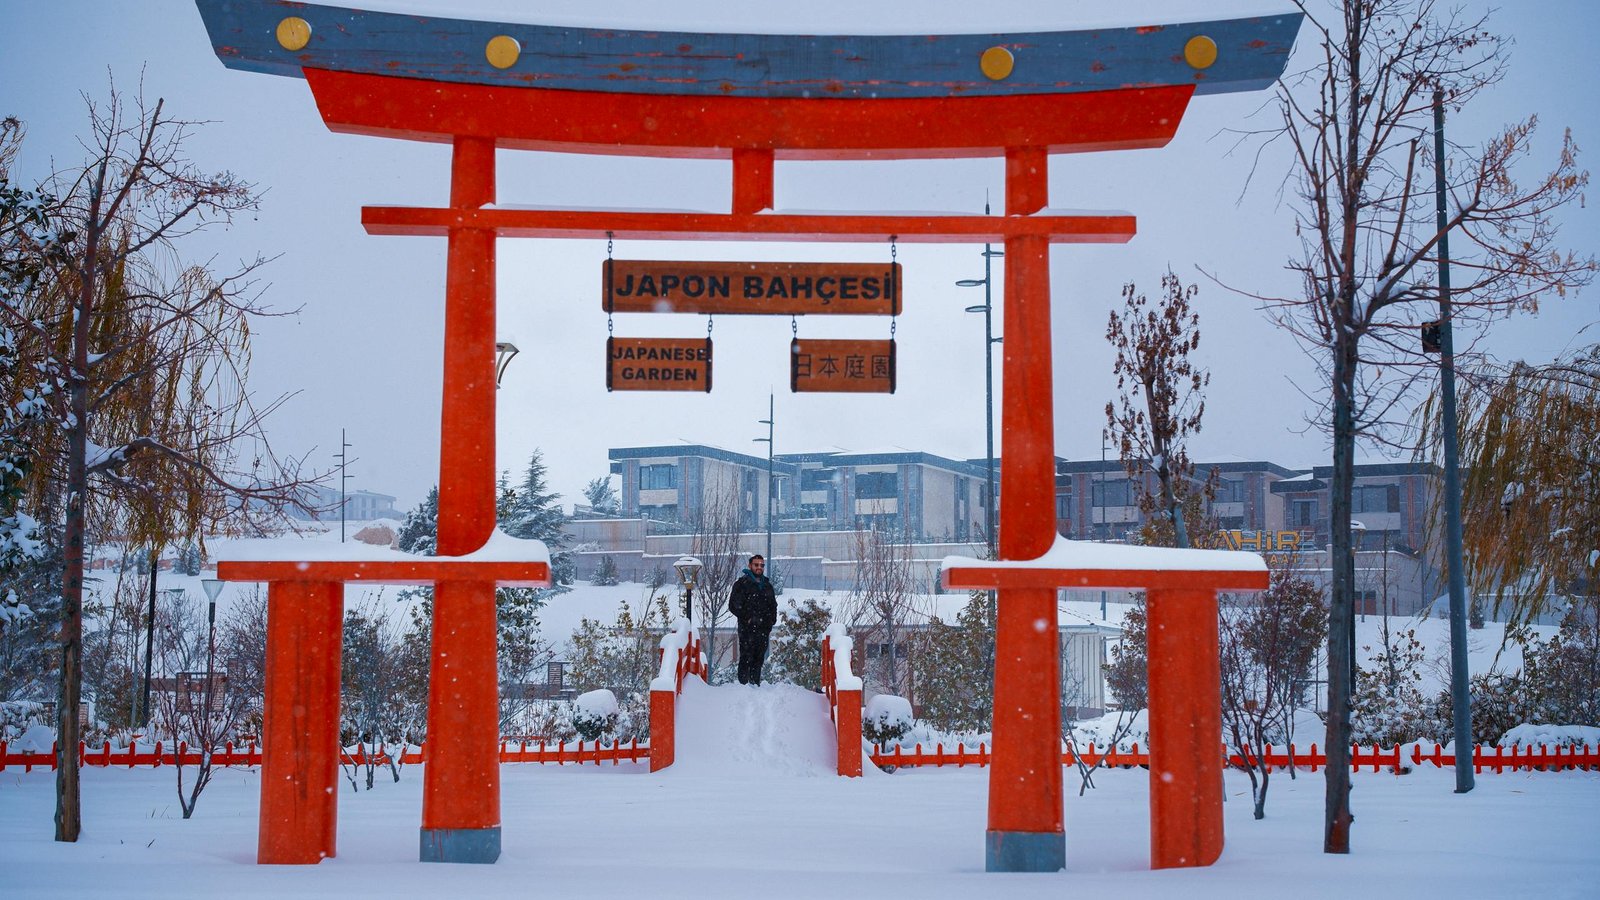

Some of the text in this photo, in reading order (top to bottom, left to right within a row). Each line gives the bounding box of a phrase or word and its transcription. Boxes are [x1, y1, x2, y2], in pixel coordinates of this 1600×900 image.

[615, 272, 891, 305] JAPON BAHÇESİ
[613, 346, 707, 361] JAPANESE
[621, 367, 697, 381] GARDEN
[797, 353, 891, 379] 日本庭園
